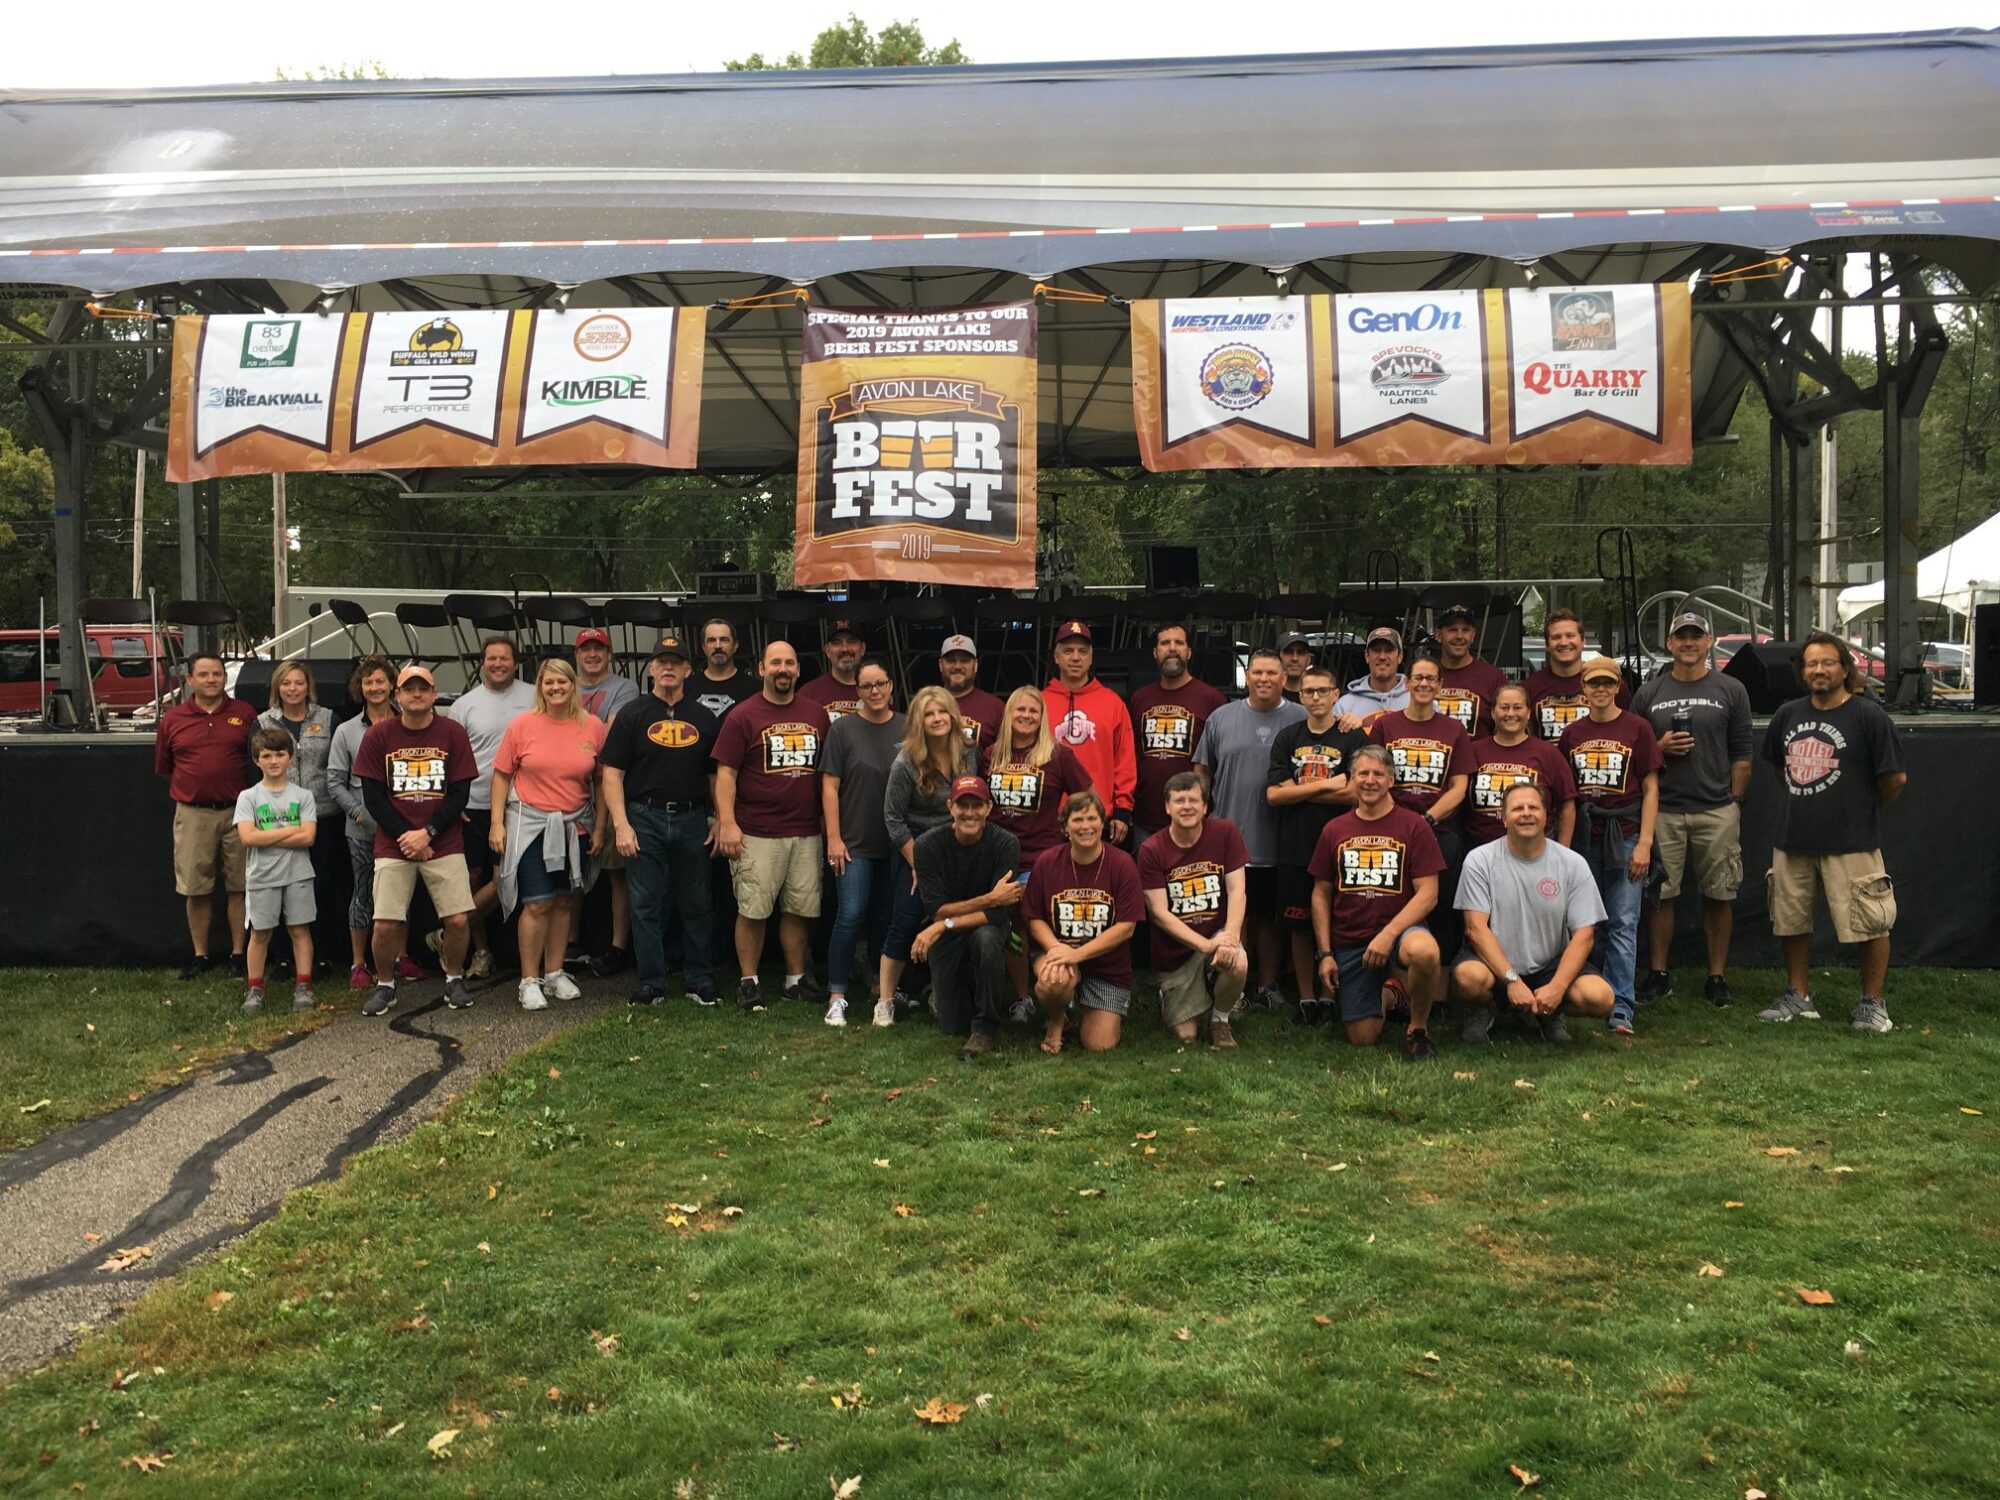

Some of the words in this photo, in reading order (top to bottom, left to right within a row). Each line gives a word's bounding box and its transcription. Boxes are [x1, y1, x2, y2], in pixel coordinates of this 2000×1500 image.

[807, 312, 879, 327] SPECIAL
[884, 313, 959, 324] THANKS
[962, 312, 988, 321] TO
[990, 308, 1028, 321] OUR
[1172, 313, 1271, 327] WESTLAND
[1348, 303, 1464, 334] GenOn
[262, 327, 282, 338] 83
[846, 326, 887, 339] 2019
[890, 325, 938, 338] AVON
[943, 323, 991, 336] LAKE
[252, 345, 285, 353] CHESTNUT
[824, 342, 870, 356] BEER
[874, 341, 919, 354] FEST
[922, 339, 1018, 353] SPONSORS
[1566, 336, 1594, 350] INN
[1371, 345, 1442, 363] SPEVOCK'S
[1523, 361, 1647, 395] QUARRY
[225, 387, 247, 396] the
[387, 375, 473, 402] T3
[541, 380, 647, 401] KIMBLE
[858, 381, 915, 402] AVON
[923, 381, 975, 402] LAKE
[1379, 389, 1437, 397] NAUTICAL
[1574, 389, 1595, 397] Bar
[1598, 389, 1608, 397] &
[1612, 388, 1638, 397] Grill
[225, 393, 323, 407] BREAKWALL
[383, 403, 471, 413] PERFORMANCE
[1390, 397, 1428, 405] LANES
[832, 420, 1003, 470] BEER
[831, 470, 1003, 522] FEST
[901, 534, 931, 560] 2019
[1651, 698, 1724, 713] FOOTBALL
[1145, 733, 1187, 748] FEST
[1797, 721, 1817, 733] BAD
[1818, 722, 1847, 749] THINGS
[771, 749, 816, 767] FEST
[1395, 765, 1443, 784] FEST
[392, 775, 446, 792] FEST
[1803, 787, 1813, 796] TO
[1344, 868, 1398, 886] FEST
[1171, 891, 1221, 914] FEST
[1059, 920, 1107, 938] FEST
